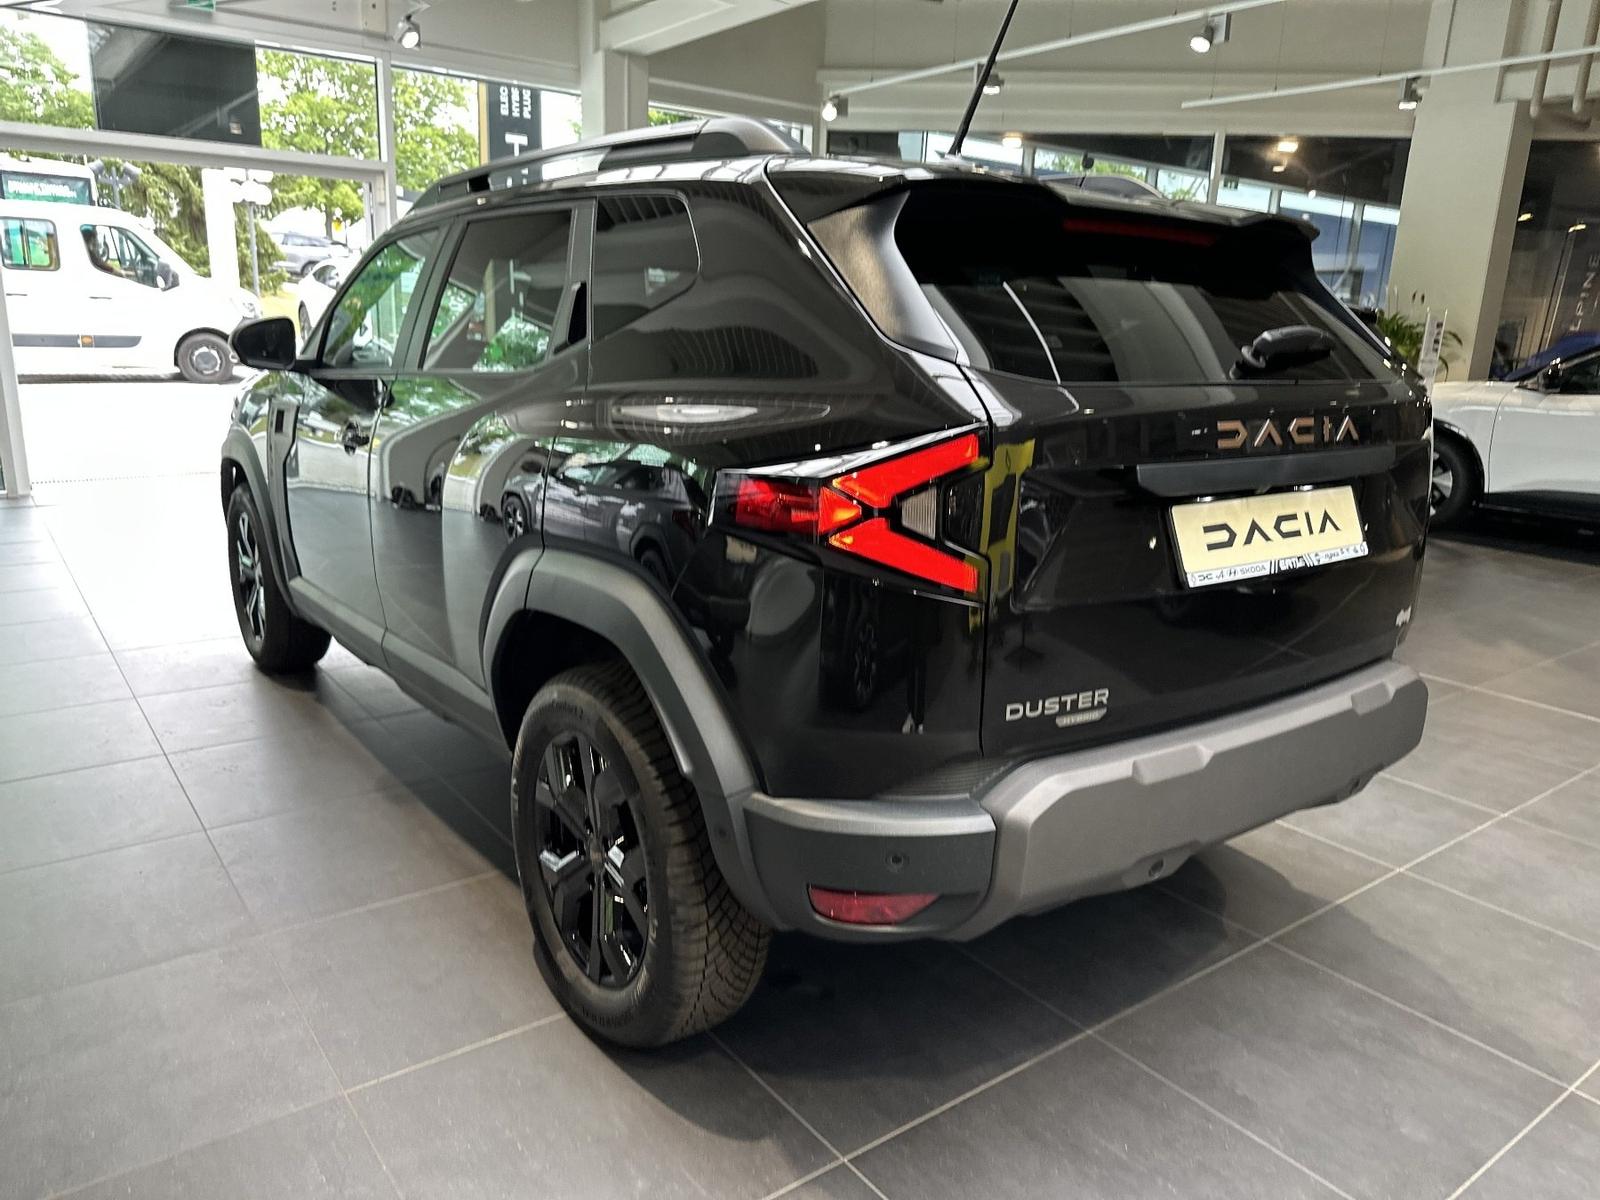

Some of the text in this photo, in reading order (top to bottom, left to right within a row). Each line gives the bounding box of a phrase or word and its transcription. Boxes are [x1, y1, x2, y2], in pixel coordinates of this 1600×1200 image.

[1217, 415, 1359, 449] DACIA
[1203, 508, 1341, 552] DACIA
[1005, 687, 1109, 721] DUSTER
